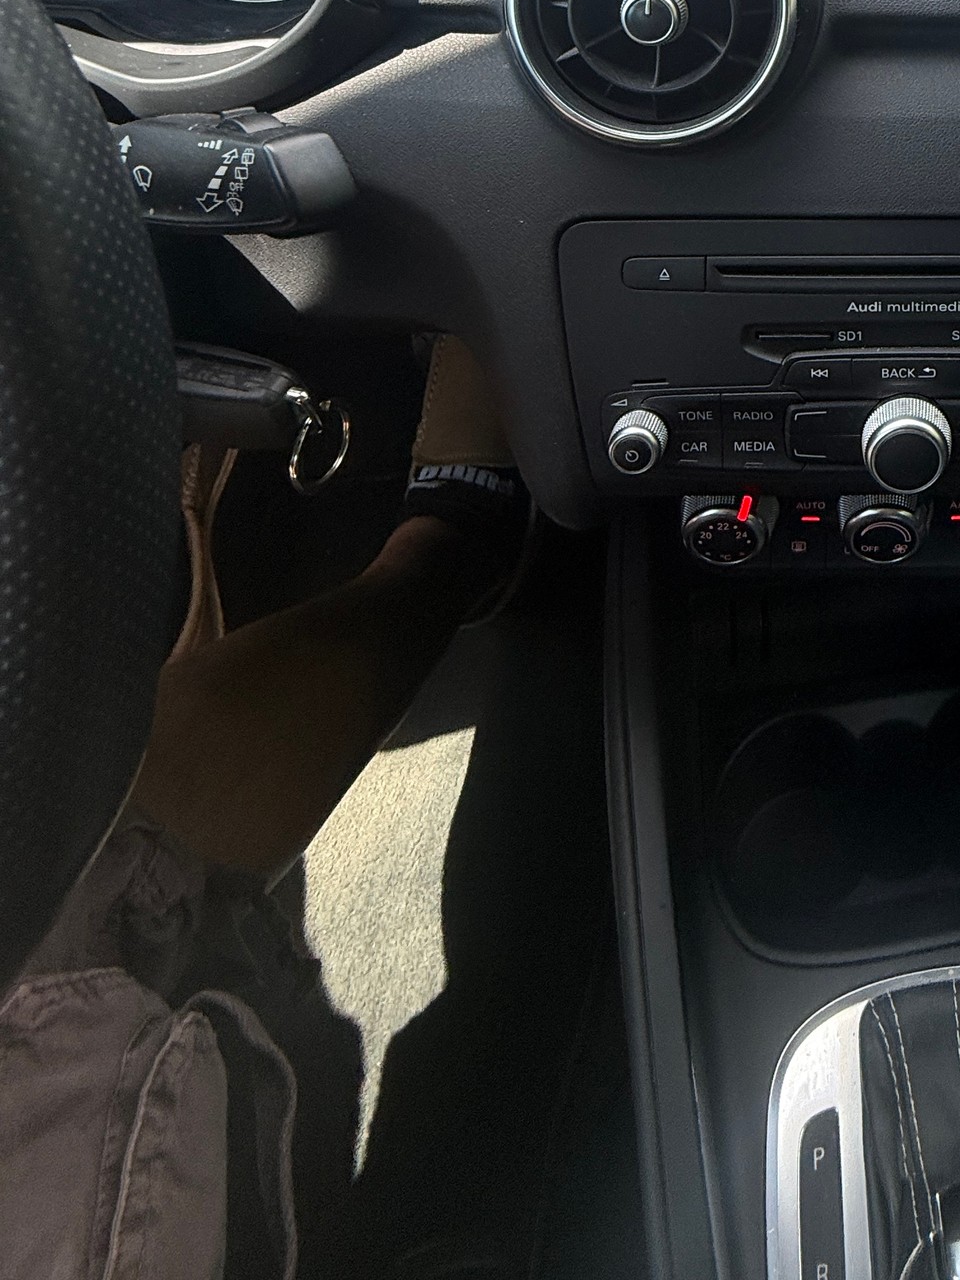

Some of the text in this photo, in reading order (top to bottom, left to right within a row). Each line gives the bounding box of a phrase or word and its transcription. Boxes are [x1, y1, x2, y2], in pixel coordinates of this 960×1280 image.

[847, 301, 882, 313] Audi
[838, 331, 863, 342] SD1
[881, 368, 916, 378] BACK
[679, 411, 713, 421] TONE
[733, 411, 774, 420] RADIO
[681, 442, 708, 452] CAR
[734, 441, 776, 452] MEDIA
[796, 501, 826, 510] AUTO
[717, 522, 730, 531] 22
[700, 531, 713, 540] 20
[735, 531, 748, 540] 24
[813, 1146, 825, 1171] P
